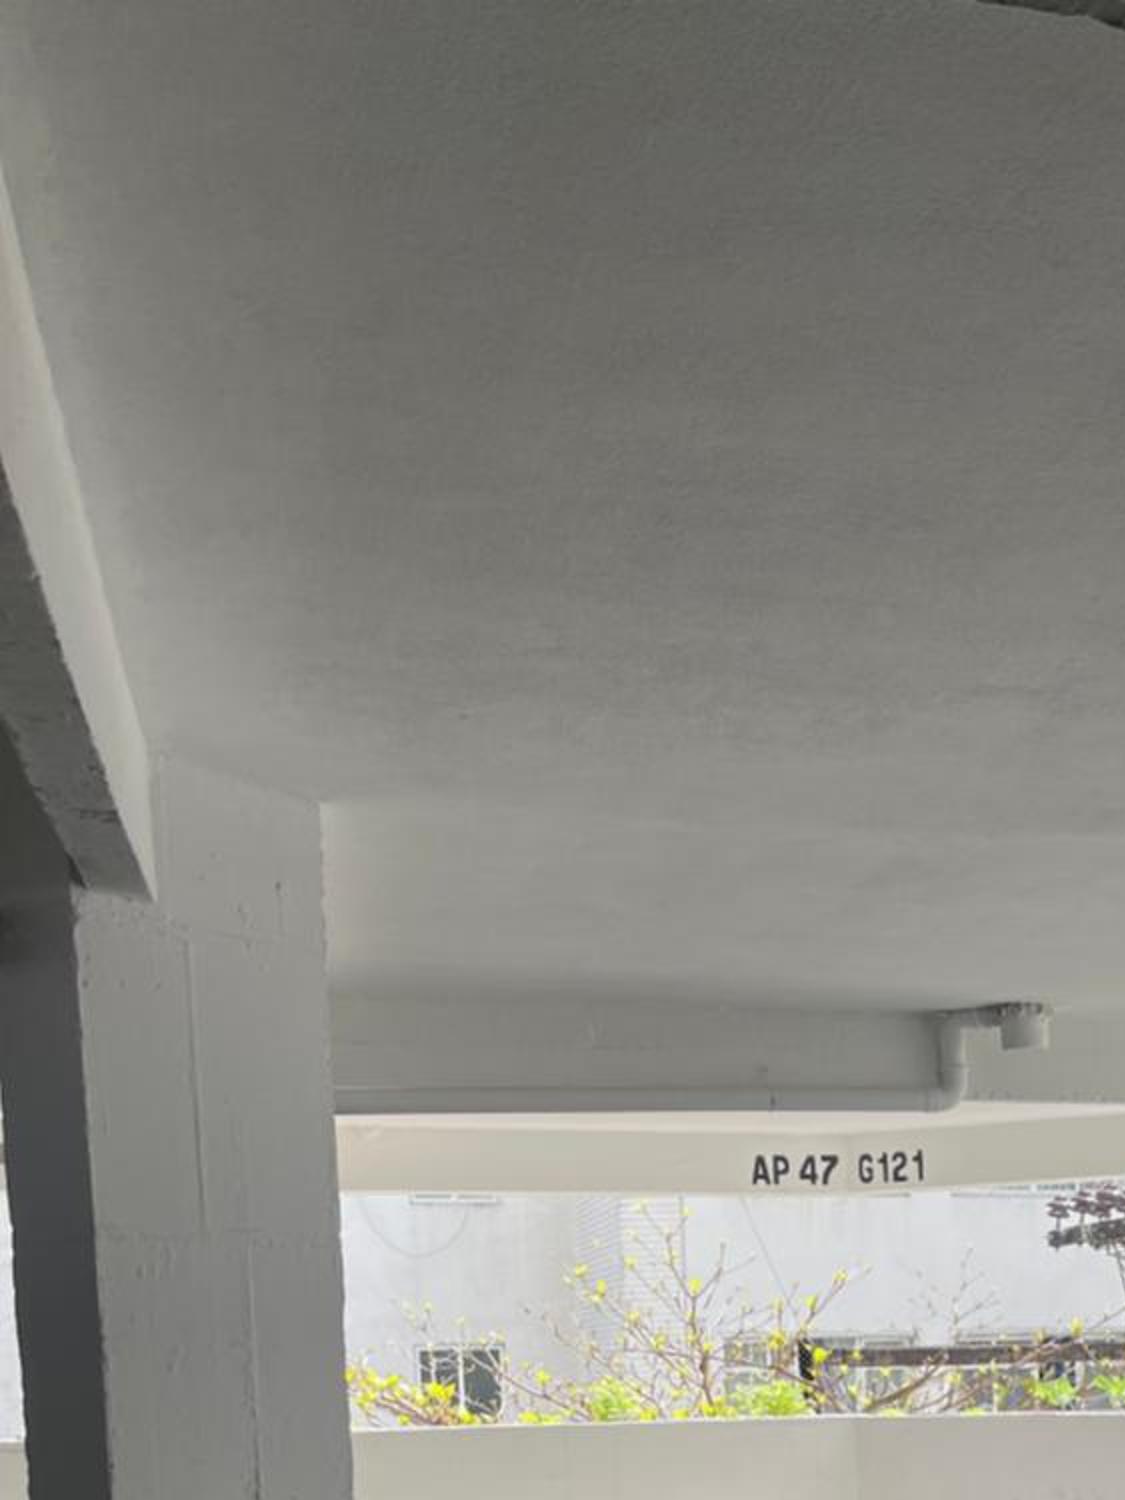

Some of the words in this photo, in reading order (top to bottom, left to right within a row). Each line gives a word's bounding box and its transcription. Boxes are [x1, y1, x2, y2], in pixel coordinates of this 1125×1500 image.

[752, 1154, 790, 1186] AP
[799, 1154, 839, 1186] 47
[857, 1149, 924, 1184] G121
